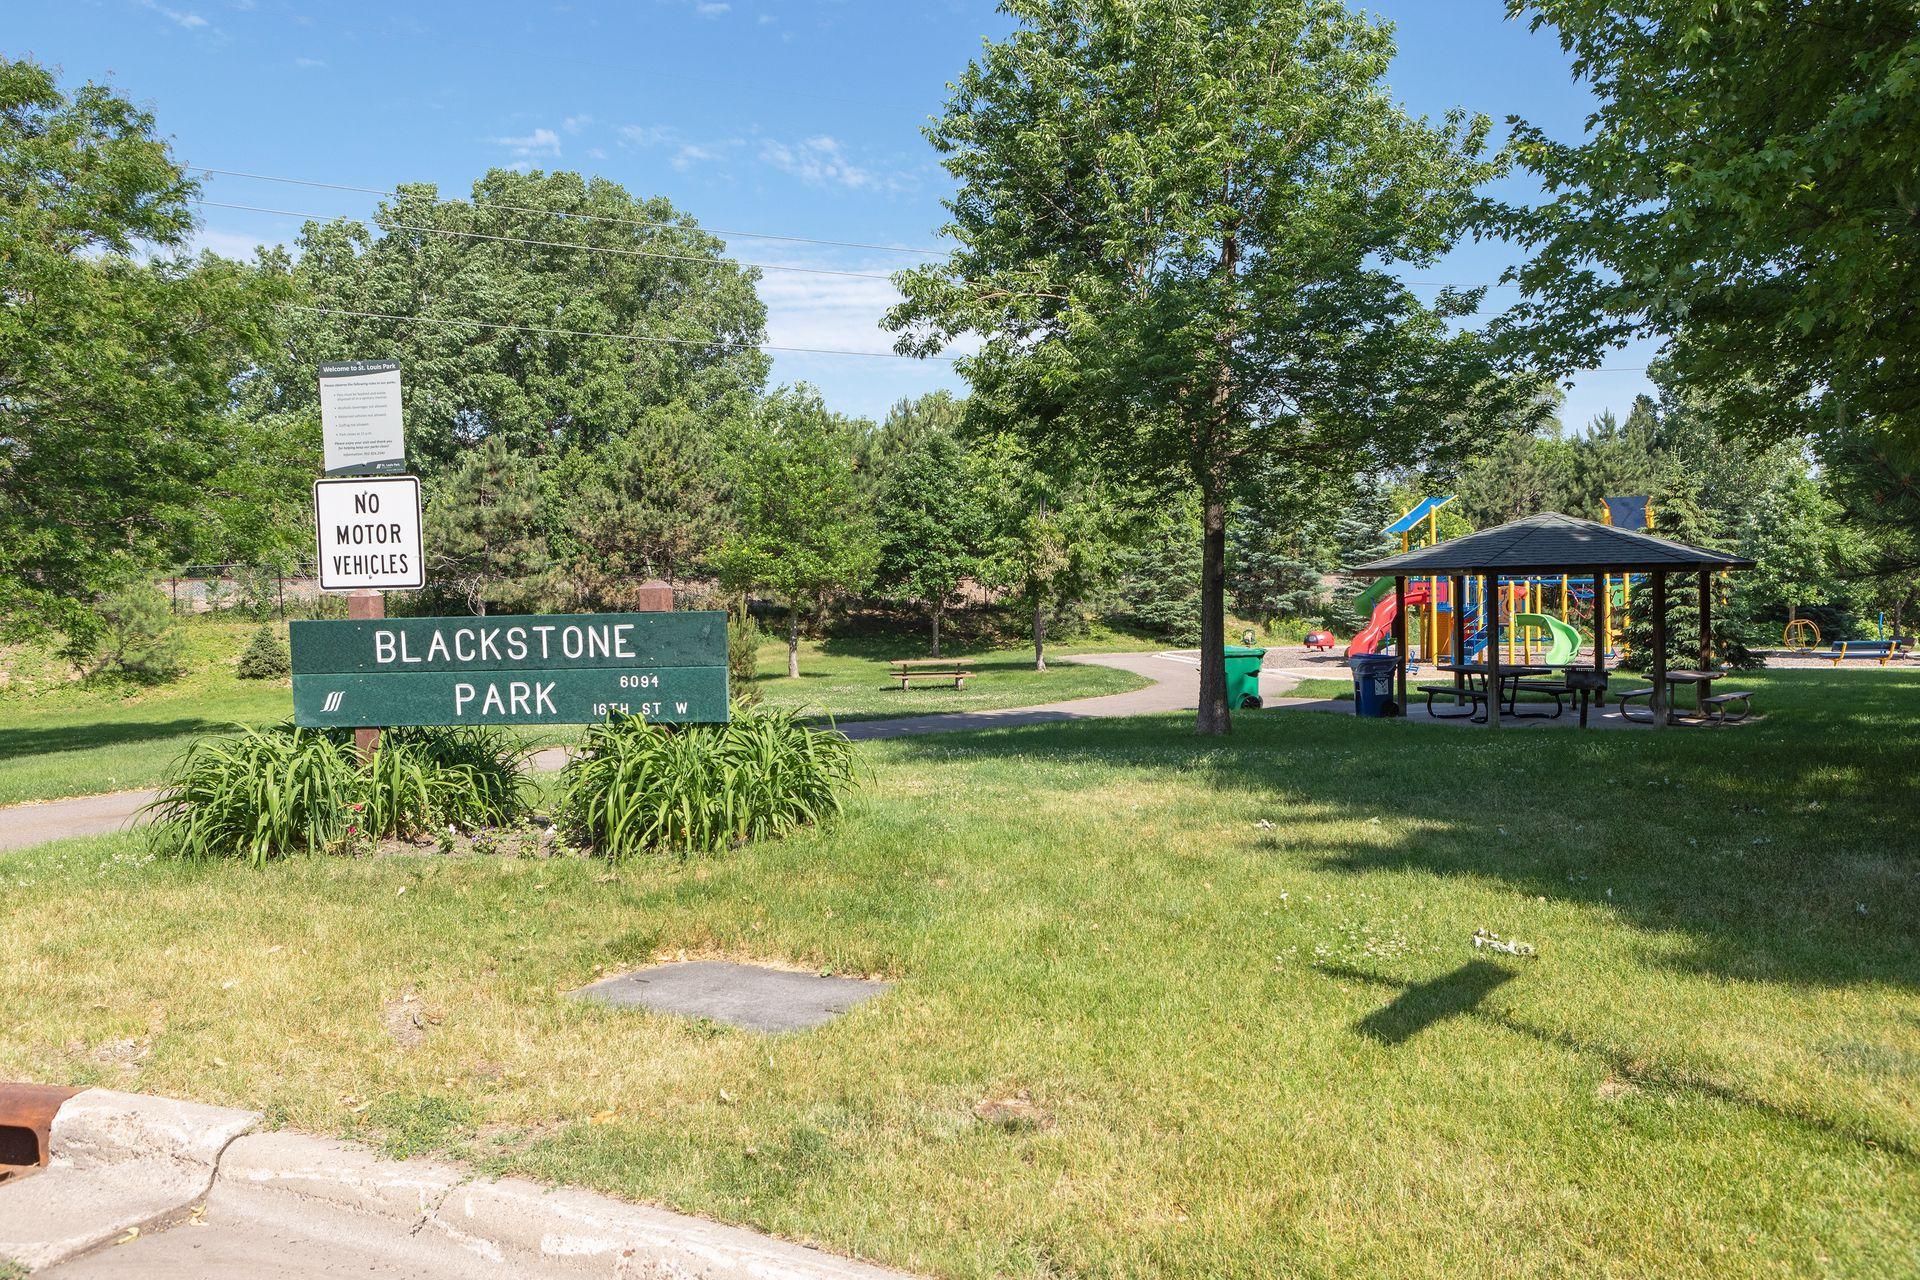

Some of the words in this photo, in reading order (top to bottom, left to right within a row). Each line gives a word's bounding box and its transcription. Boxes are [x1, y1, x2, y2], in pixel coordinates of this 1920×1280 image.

[354, 493, 380, 514] NO
[336, 524, 402, 545] MOTOR
[333, 553, 408, 575] VEHICLES
[374, 624, 636, 664] BLACKSTONE
[620, 675, 659, 688] 6094
[454, 681, 558, 716] PARK
[593, 703, 629, 716] 16TH
[642, 702, 662, 715] ST
[676, 702, 688, 714] W
